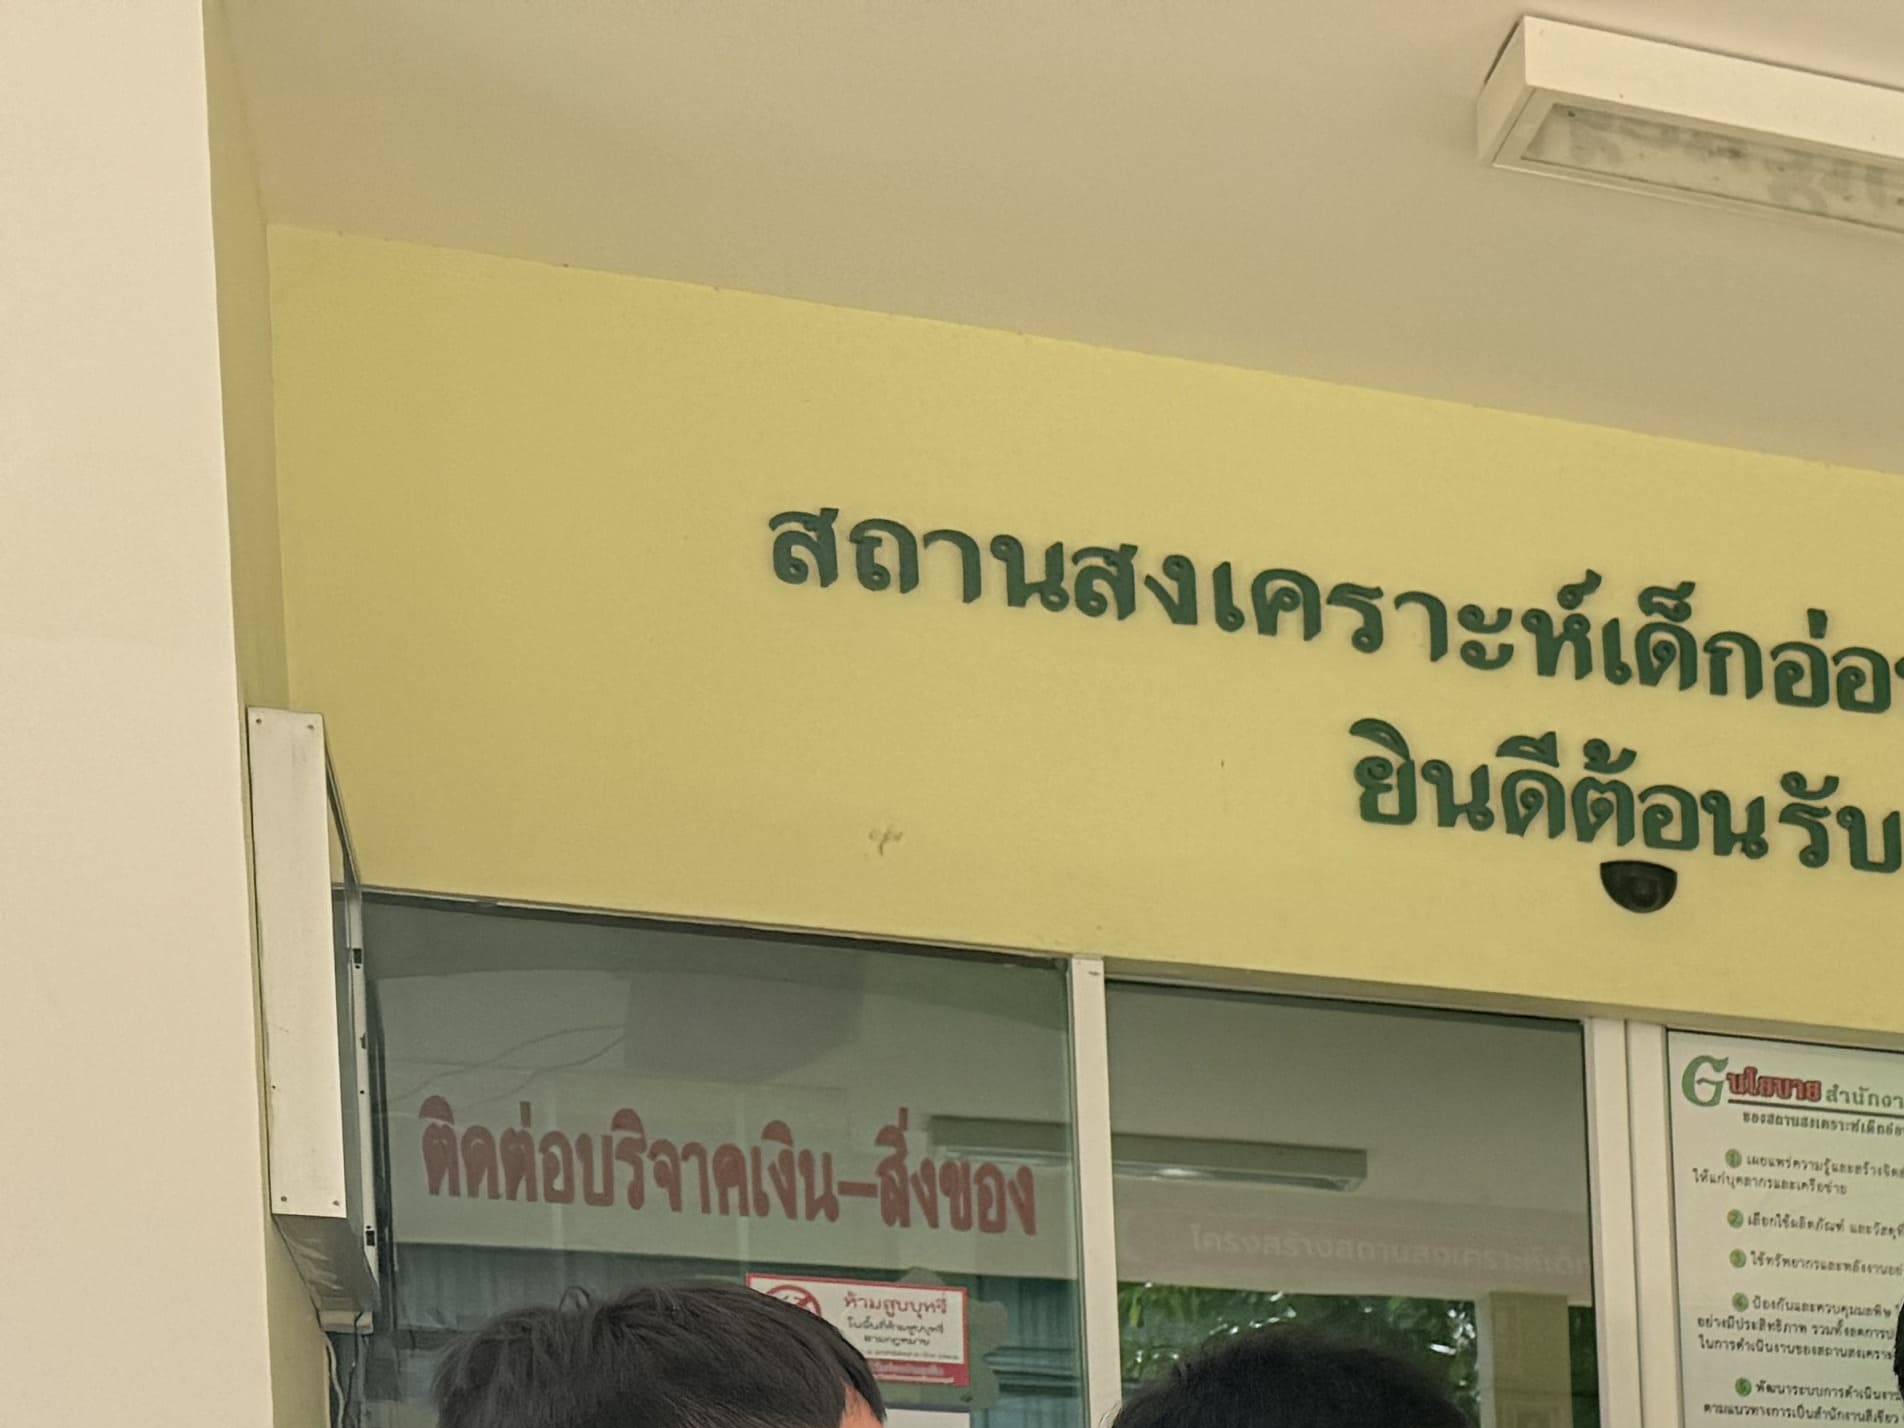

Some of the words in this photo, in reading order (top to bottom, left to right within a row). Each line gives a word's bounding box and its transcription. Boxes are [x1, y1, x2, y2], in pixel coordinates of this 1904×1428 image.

[1349, 718, 1903, 874] ยินดีต้อนรับ
[419, 1095, 1037, 1236] ติดต่อบริจาคเงิน-สิ่งของ
